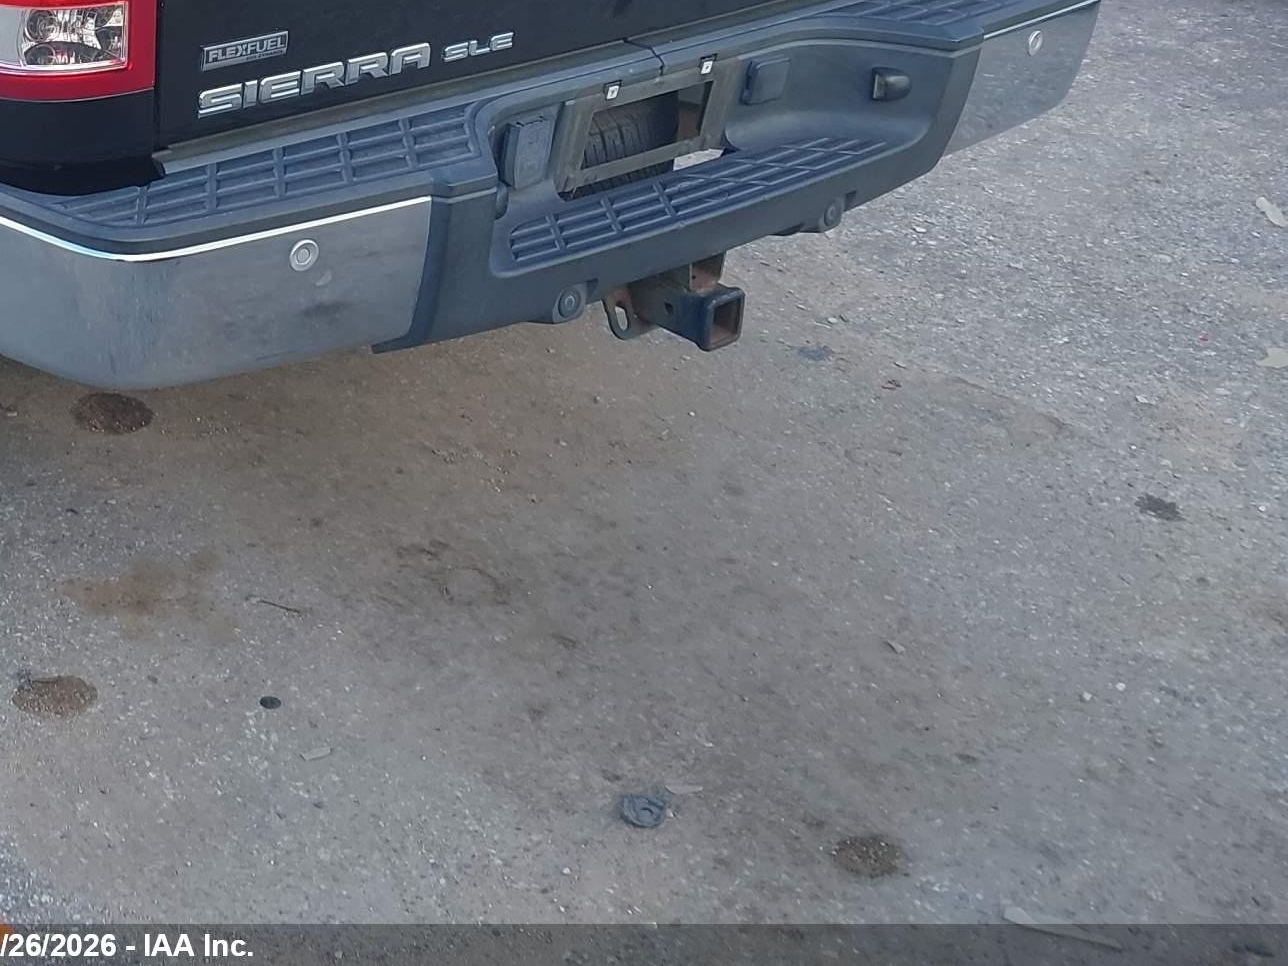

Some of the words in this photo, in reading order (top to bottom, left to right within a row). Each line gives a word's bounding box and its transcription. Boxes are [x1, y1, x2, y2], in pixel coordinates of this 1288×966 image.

[198, 42, 431, 118] SIERRA
[443, 32, 514, 62] SLE
[208, 37, 285, 62] FLEXFUEL
